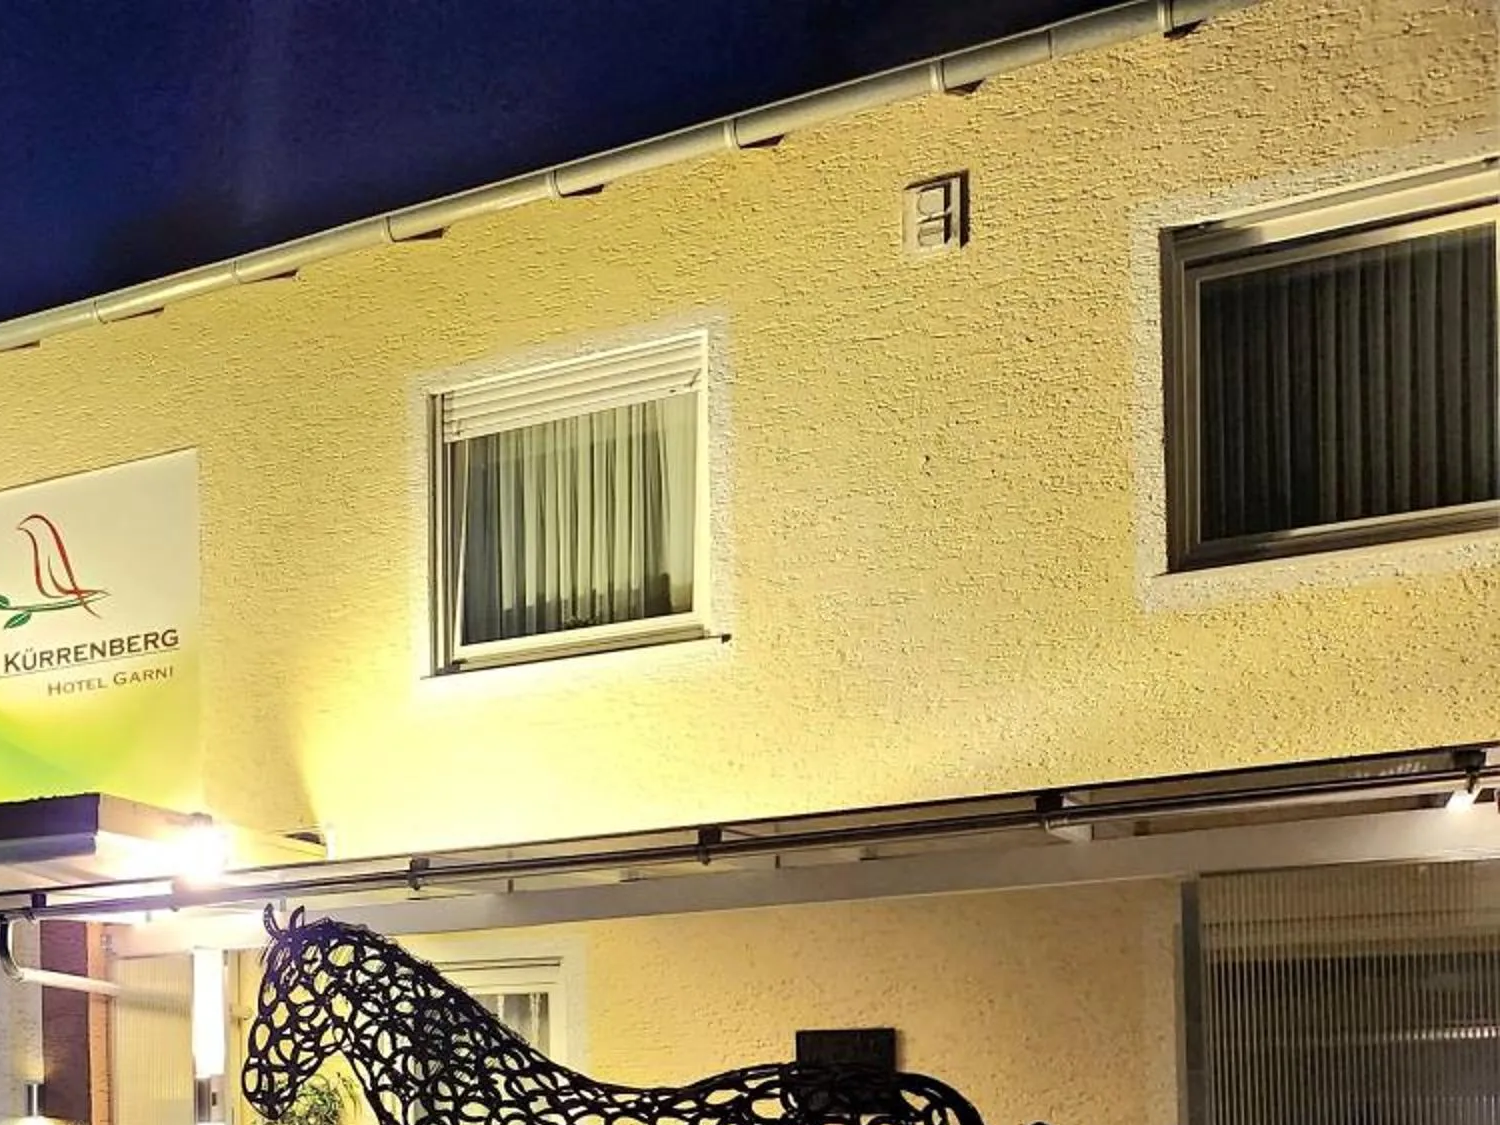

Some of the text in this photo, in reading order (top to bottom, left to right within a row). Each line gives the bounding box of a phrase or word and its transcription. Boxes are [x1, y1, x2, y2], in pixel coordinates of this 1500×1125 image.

[3, 628, 180, 674] KÜRRENBERG
[47, 665, 175, 697] HOTEL GARNI
